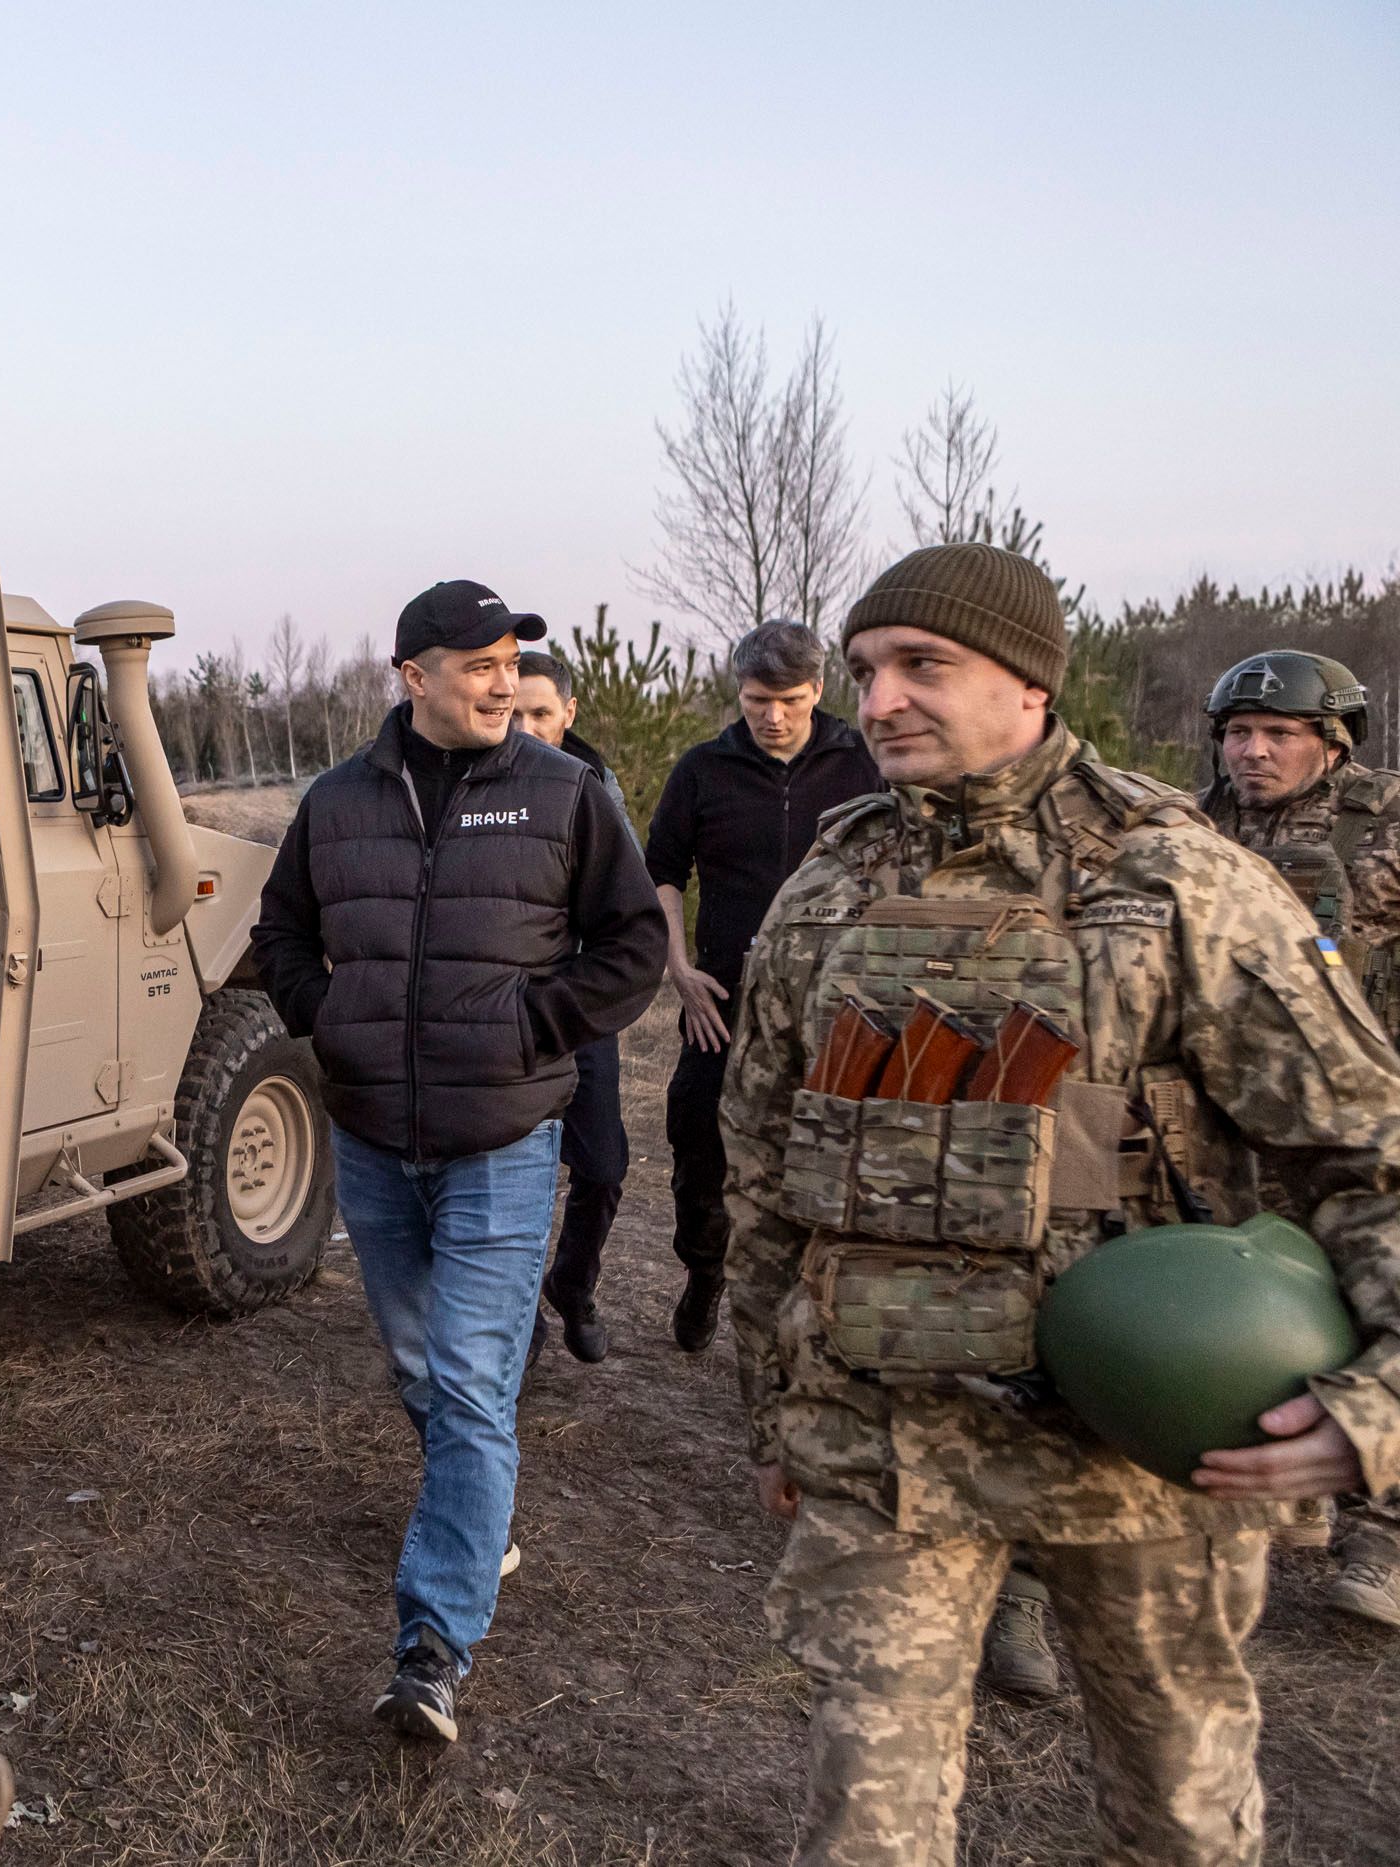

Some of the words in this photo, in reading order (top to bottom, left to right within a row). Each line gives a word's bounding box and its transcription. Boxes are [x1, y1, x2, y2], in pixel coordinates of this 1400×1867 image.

[478, 597, 503, 608] BRAVE
[460, 807, 530, 827] BRAVE1
[140, 967, 178, 981] VAMTAC
[148, 983, 171, 998] ST5
